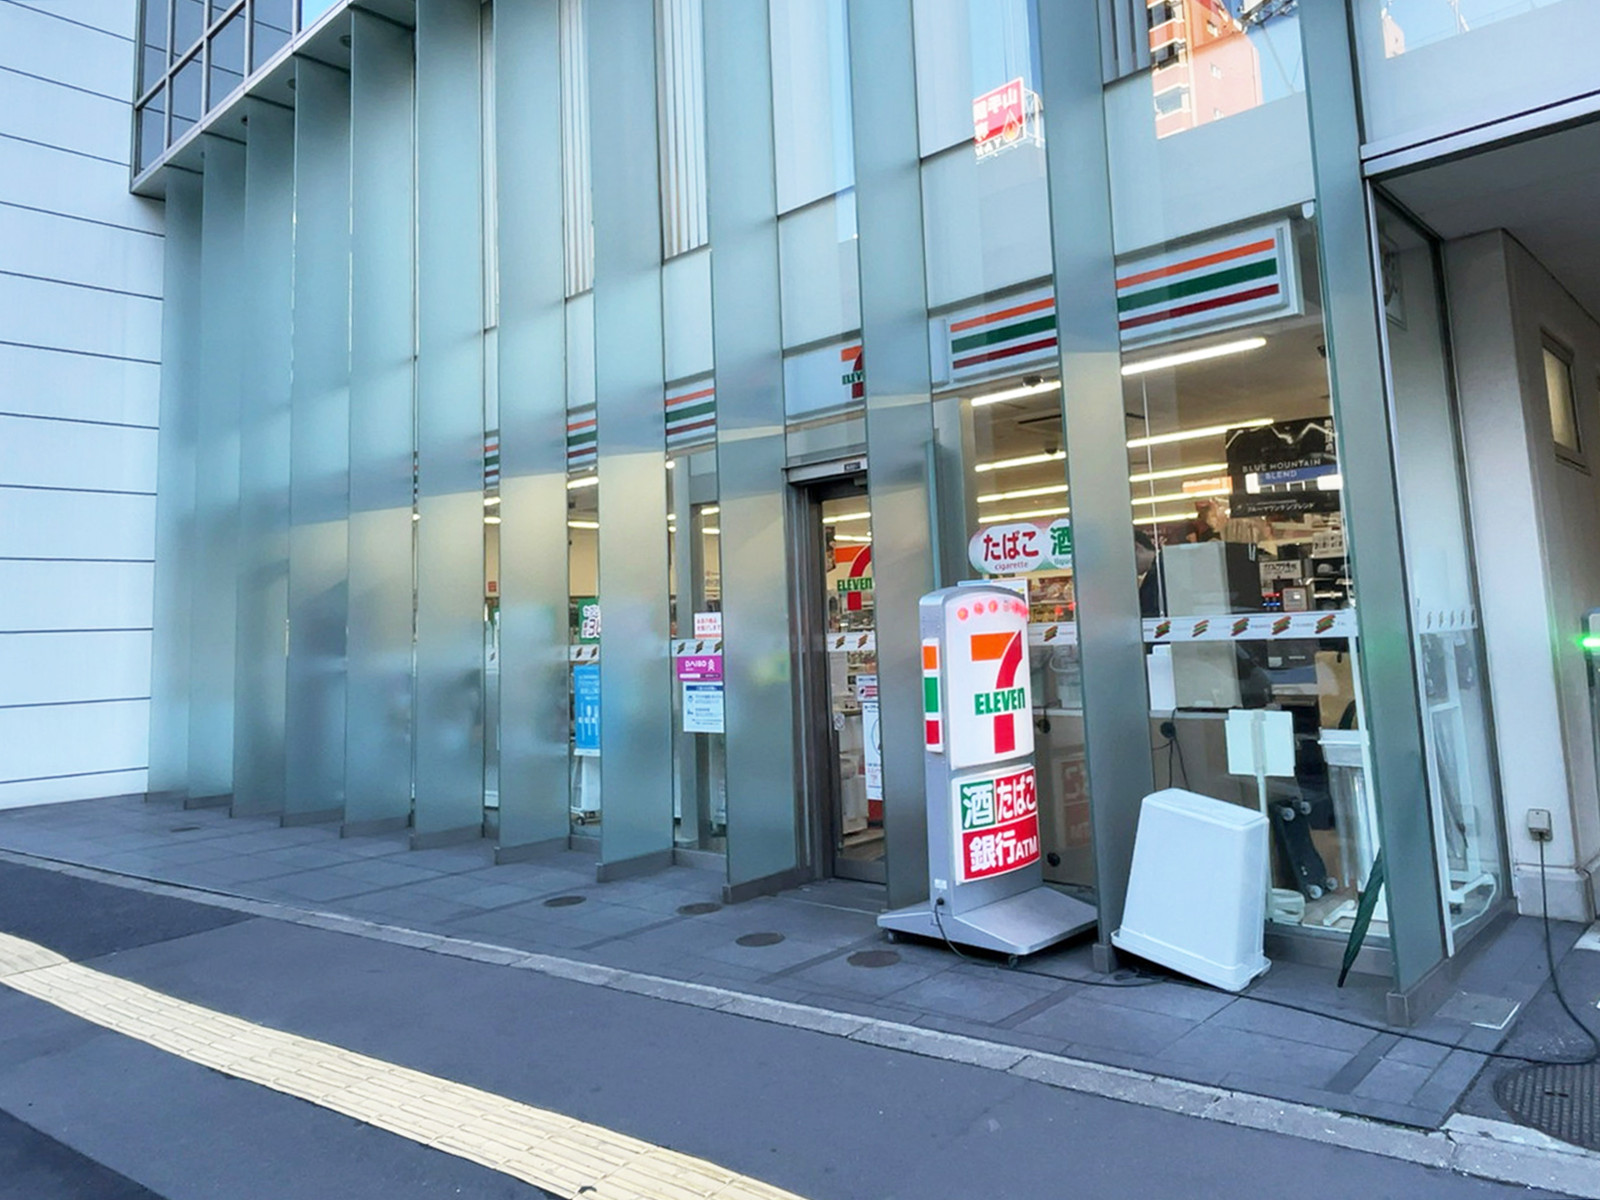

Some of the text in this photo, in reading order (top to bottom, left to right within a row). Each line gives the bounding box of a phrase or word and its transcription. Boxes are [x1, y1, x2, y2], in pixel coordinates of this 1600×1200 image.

[1242, 459, 1321, 473] BLUE MOUNTAIN
[1265, 470, 1298, 480] BLEND
[984, 526, 1072, 561] たばこ 酒
[837, 546, 872, 610] 7
[994, 562, 1028, 571] cigarette
[837, 578, 873, 592] ELEVEN
[970, 630, 1023, 754] 7
[974, 687, 1026, 716] ELEVEN
[963, 785, 994, 828] 酒
[997, 775, 1037, 819] たばこ
